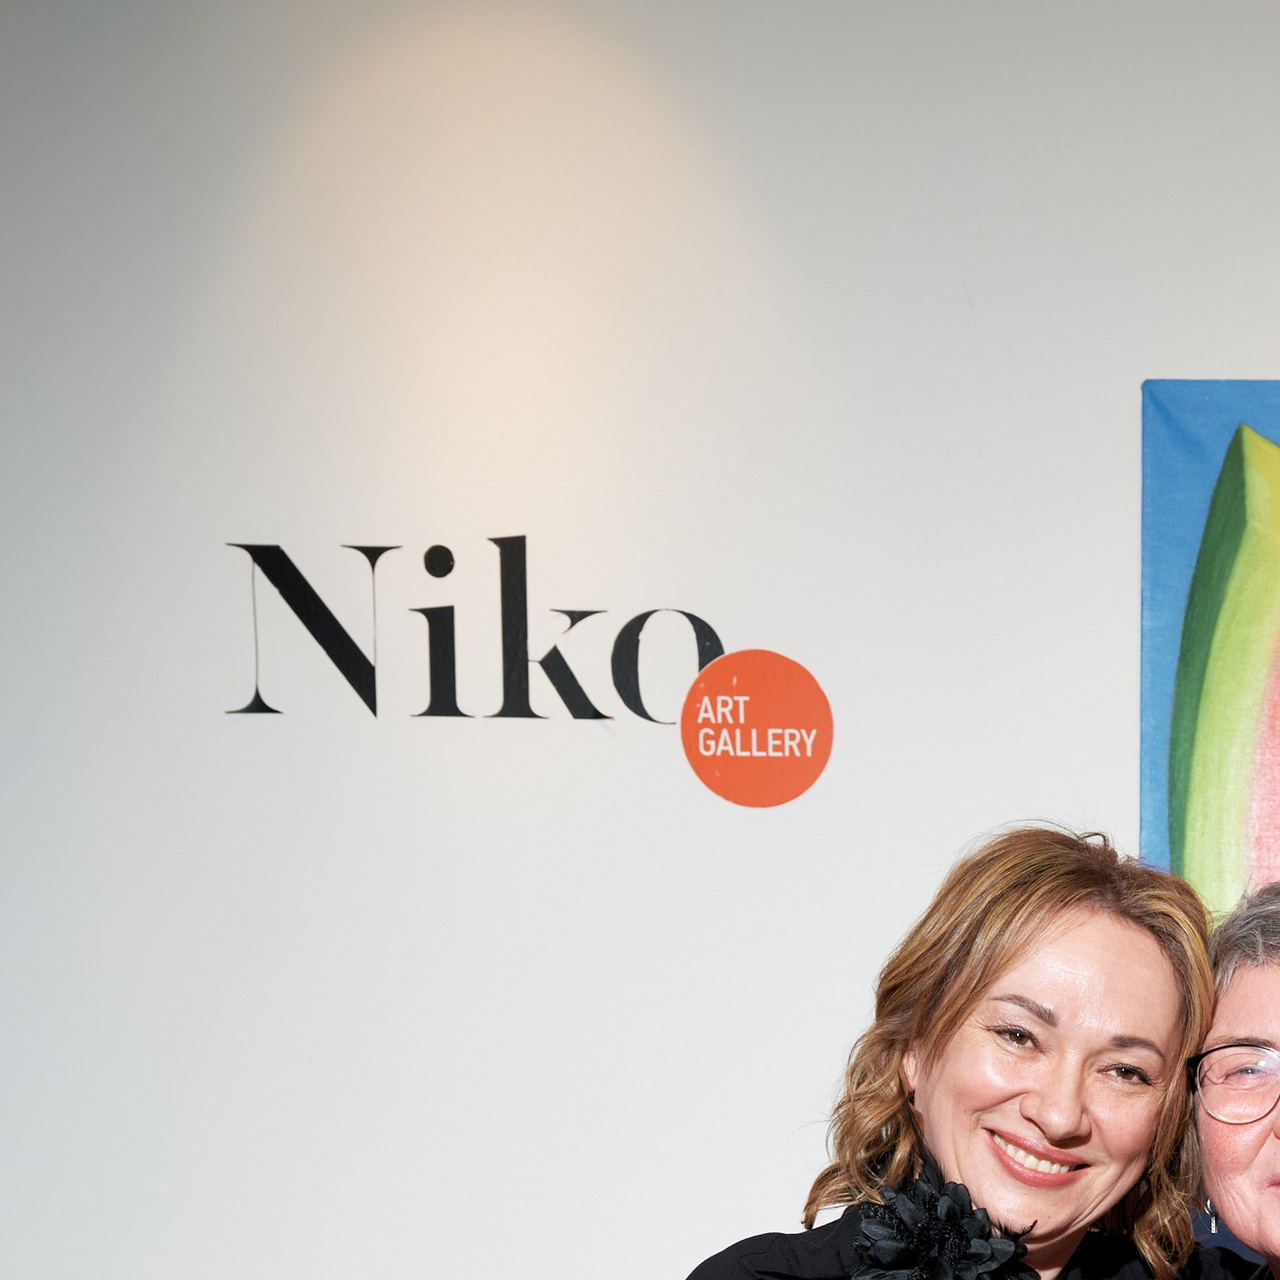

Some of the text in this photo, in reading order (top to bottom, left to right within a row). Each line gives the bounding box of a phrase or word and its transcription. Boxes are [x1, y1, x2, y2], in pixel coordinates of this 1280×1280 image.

[224, 535, 726, 725] Niko
[697, 695, 750, 724] ART
[698, 727, 817, 757] GALLERY
